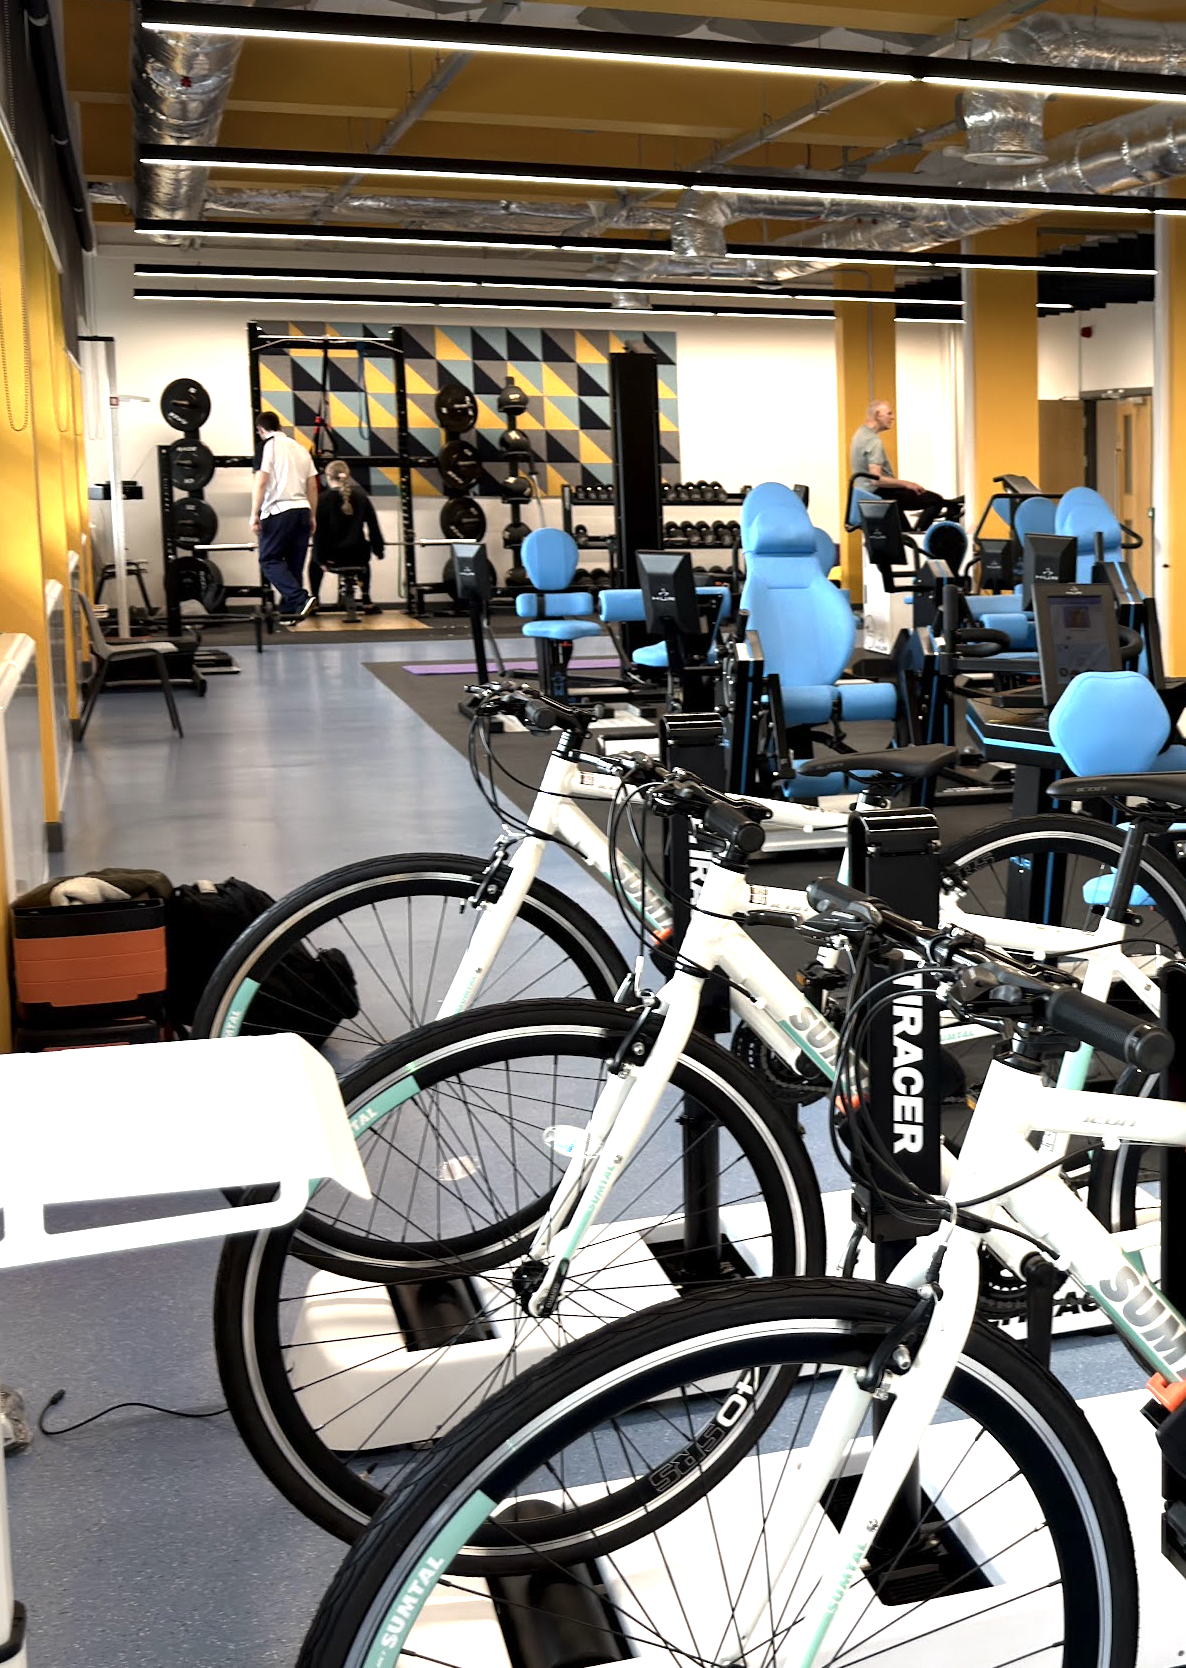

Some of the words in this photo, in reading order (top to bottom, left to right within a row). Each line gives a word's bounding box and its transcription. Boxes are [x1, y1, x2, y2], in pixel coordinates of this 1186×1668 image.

[892, 948, 925, 1155] TIRACER
[350, 1107, 379, 1131] TAL
[380, 1555, 446, 1649] SUMTAL
